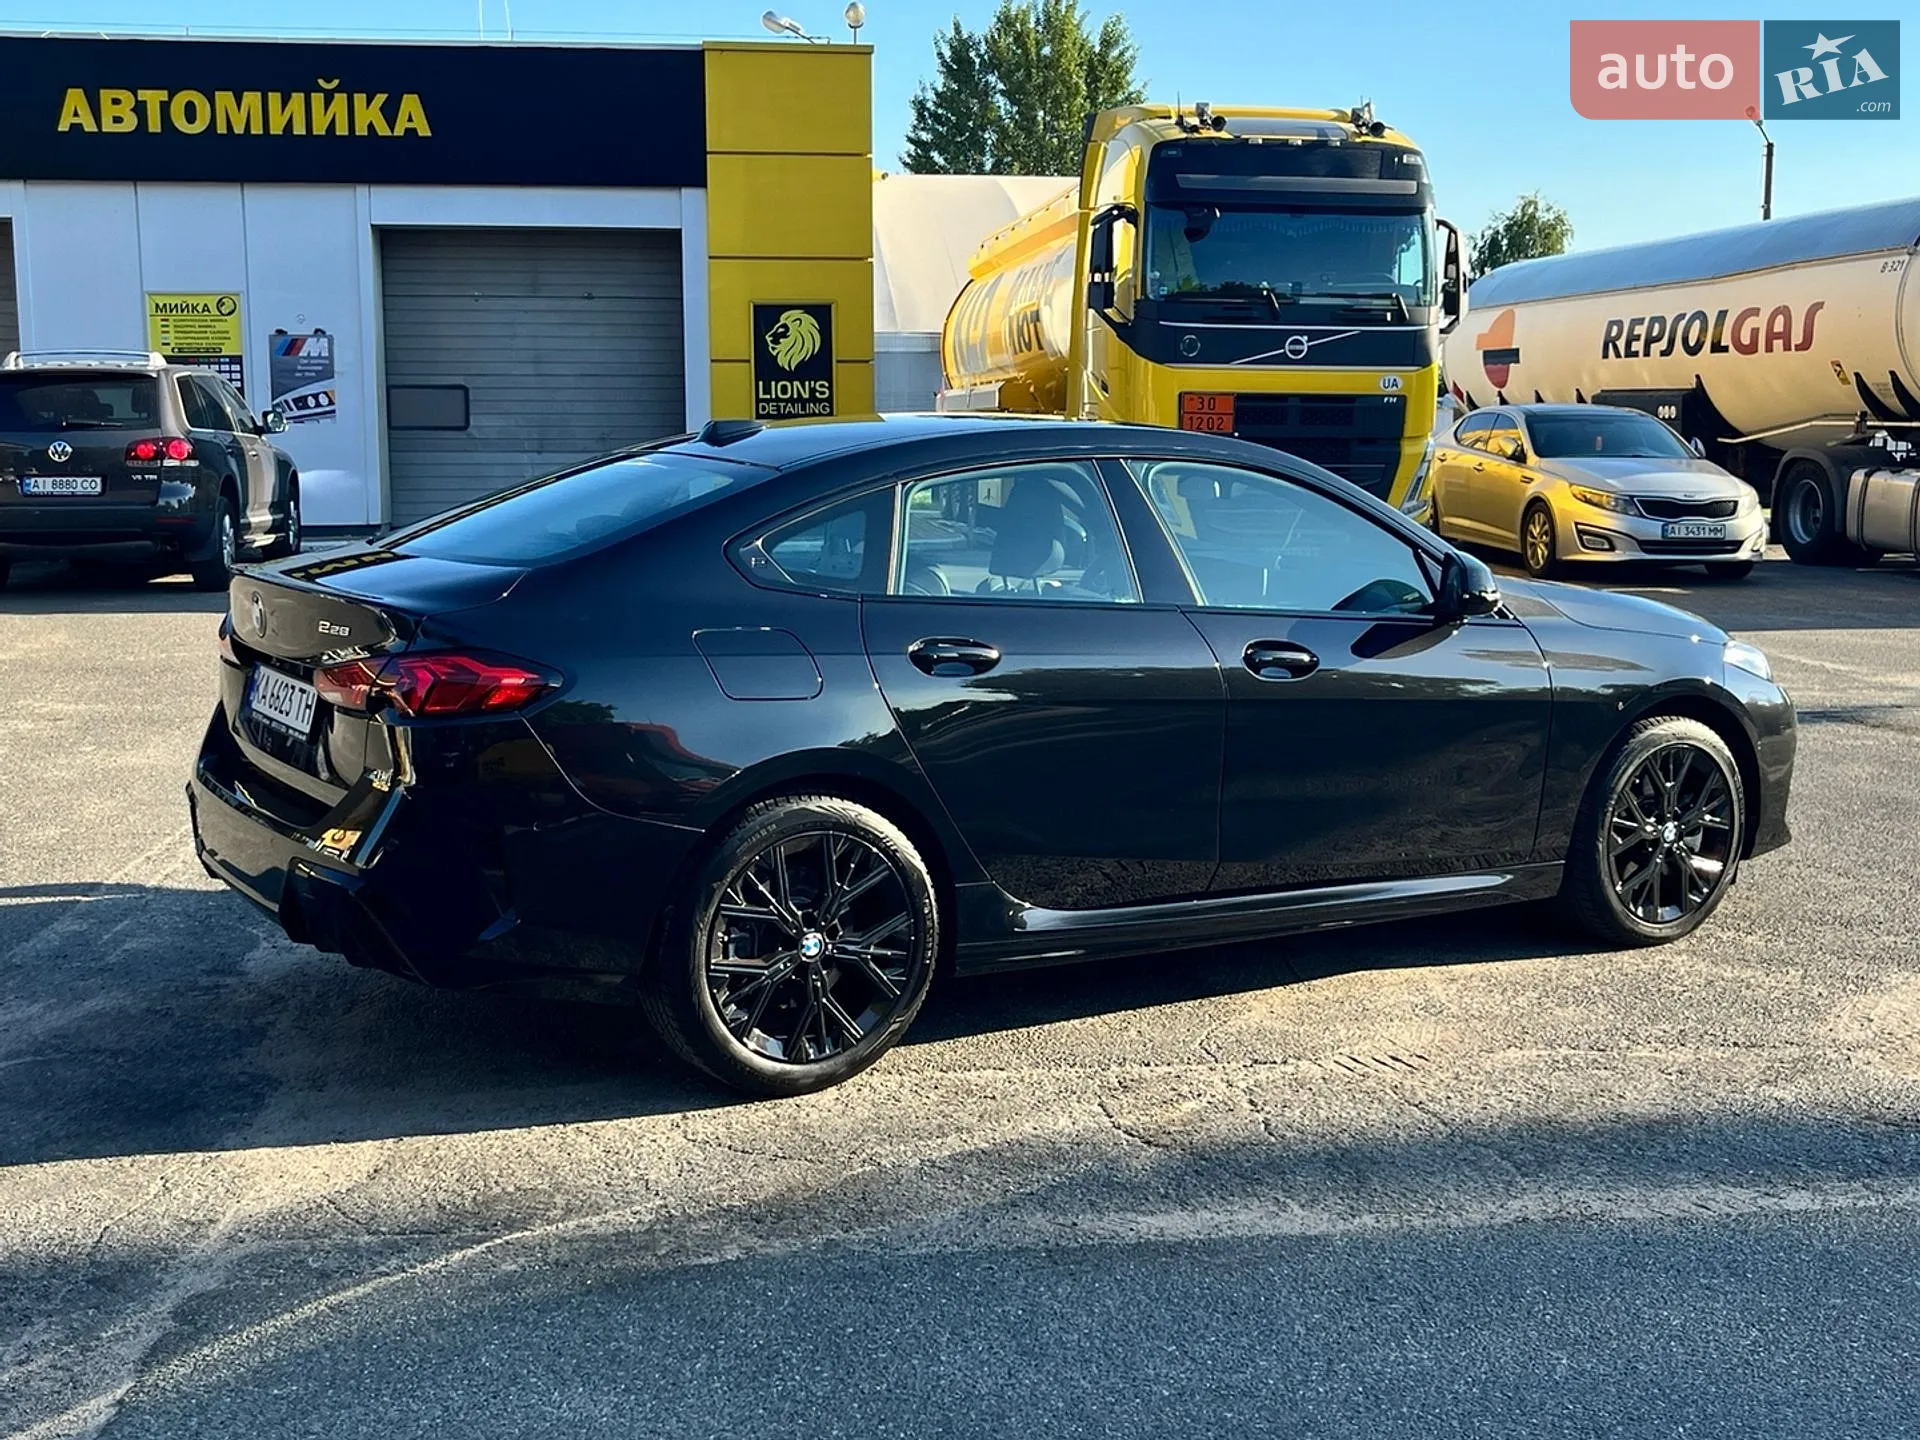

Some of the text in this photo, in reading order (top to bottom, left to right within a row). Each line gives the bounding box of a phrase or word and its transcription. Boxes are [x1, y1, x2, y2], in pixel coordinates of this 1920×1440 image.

[57, 78, 432, 137] АВТОМИЙКА
[154, 300, 212, 314] МИЙКА
[758, 380, 830, 399] LION'S
[1382, 377, 1399, 389] UA
[758, 402, 831, 415] DETAILING
[1197, 396, 1216, 411] 30
[1188, 416, 1225, 431] 1202
[32, 478, 99, 490] AI 8880 CO
[1668, 526, 1680, 536] AI
[1708, 526, 1723, 536] MM
[318, 620, 350, 636] 228
[268, 678, 296, 717] 6623
[295, 686, 316, 726] TH
